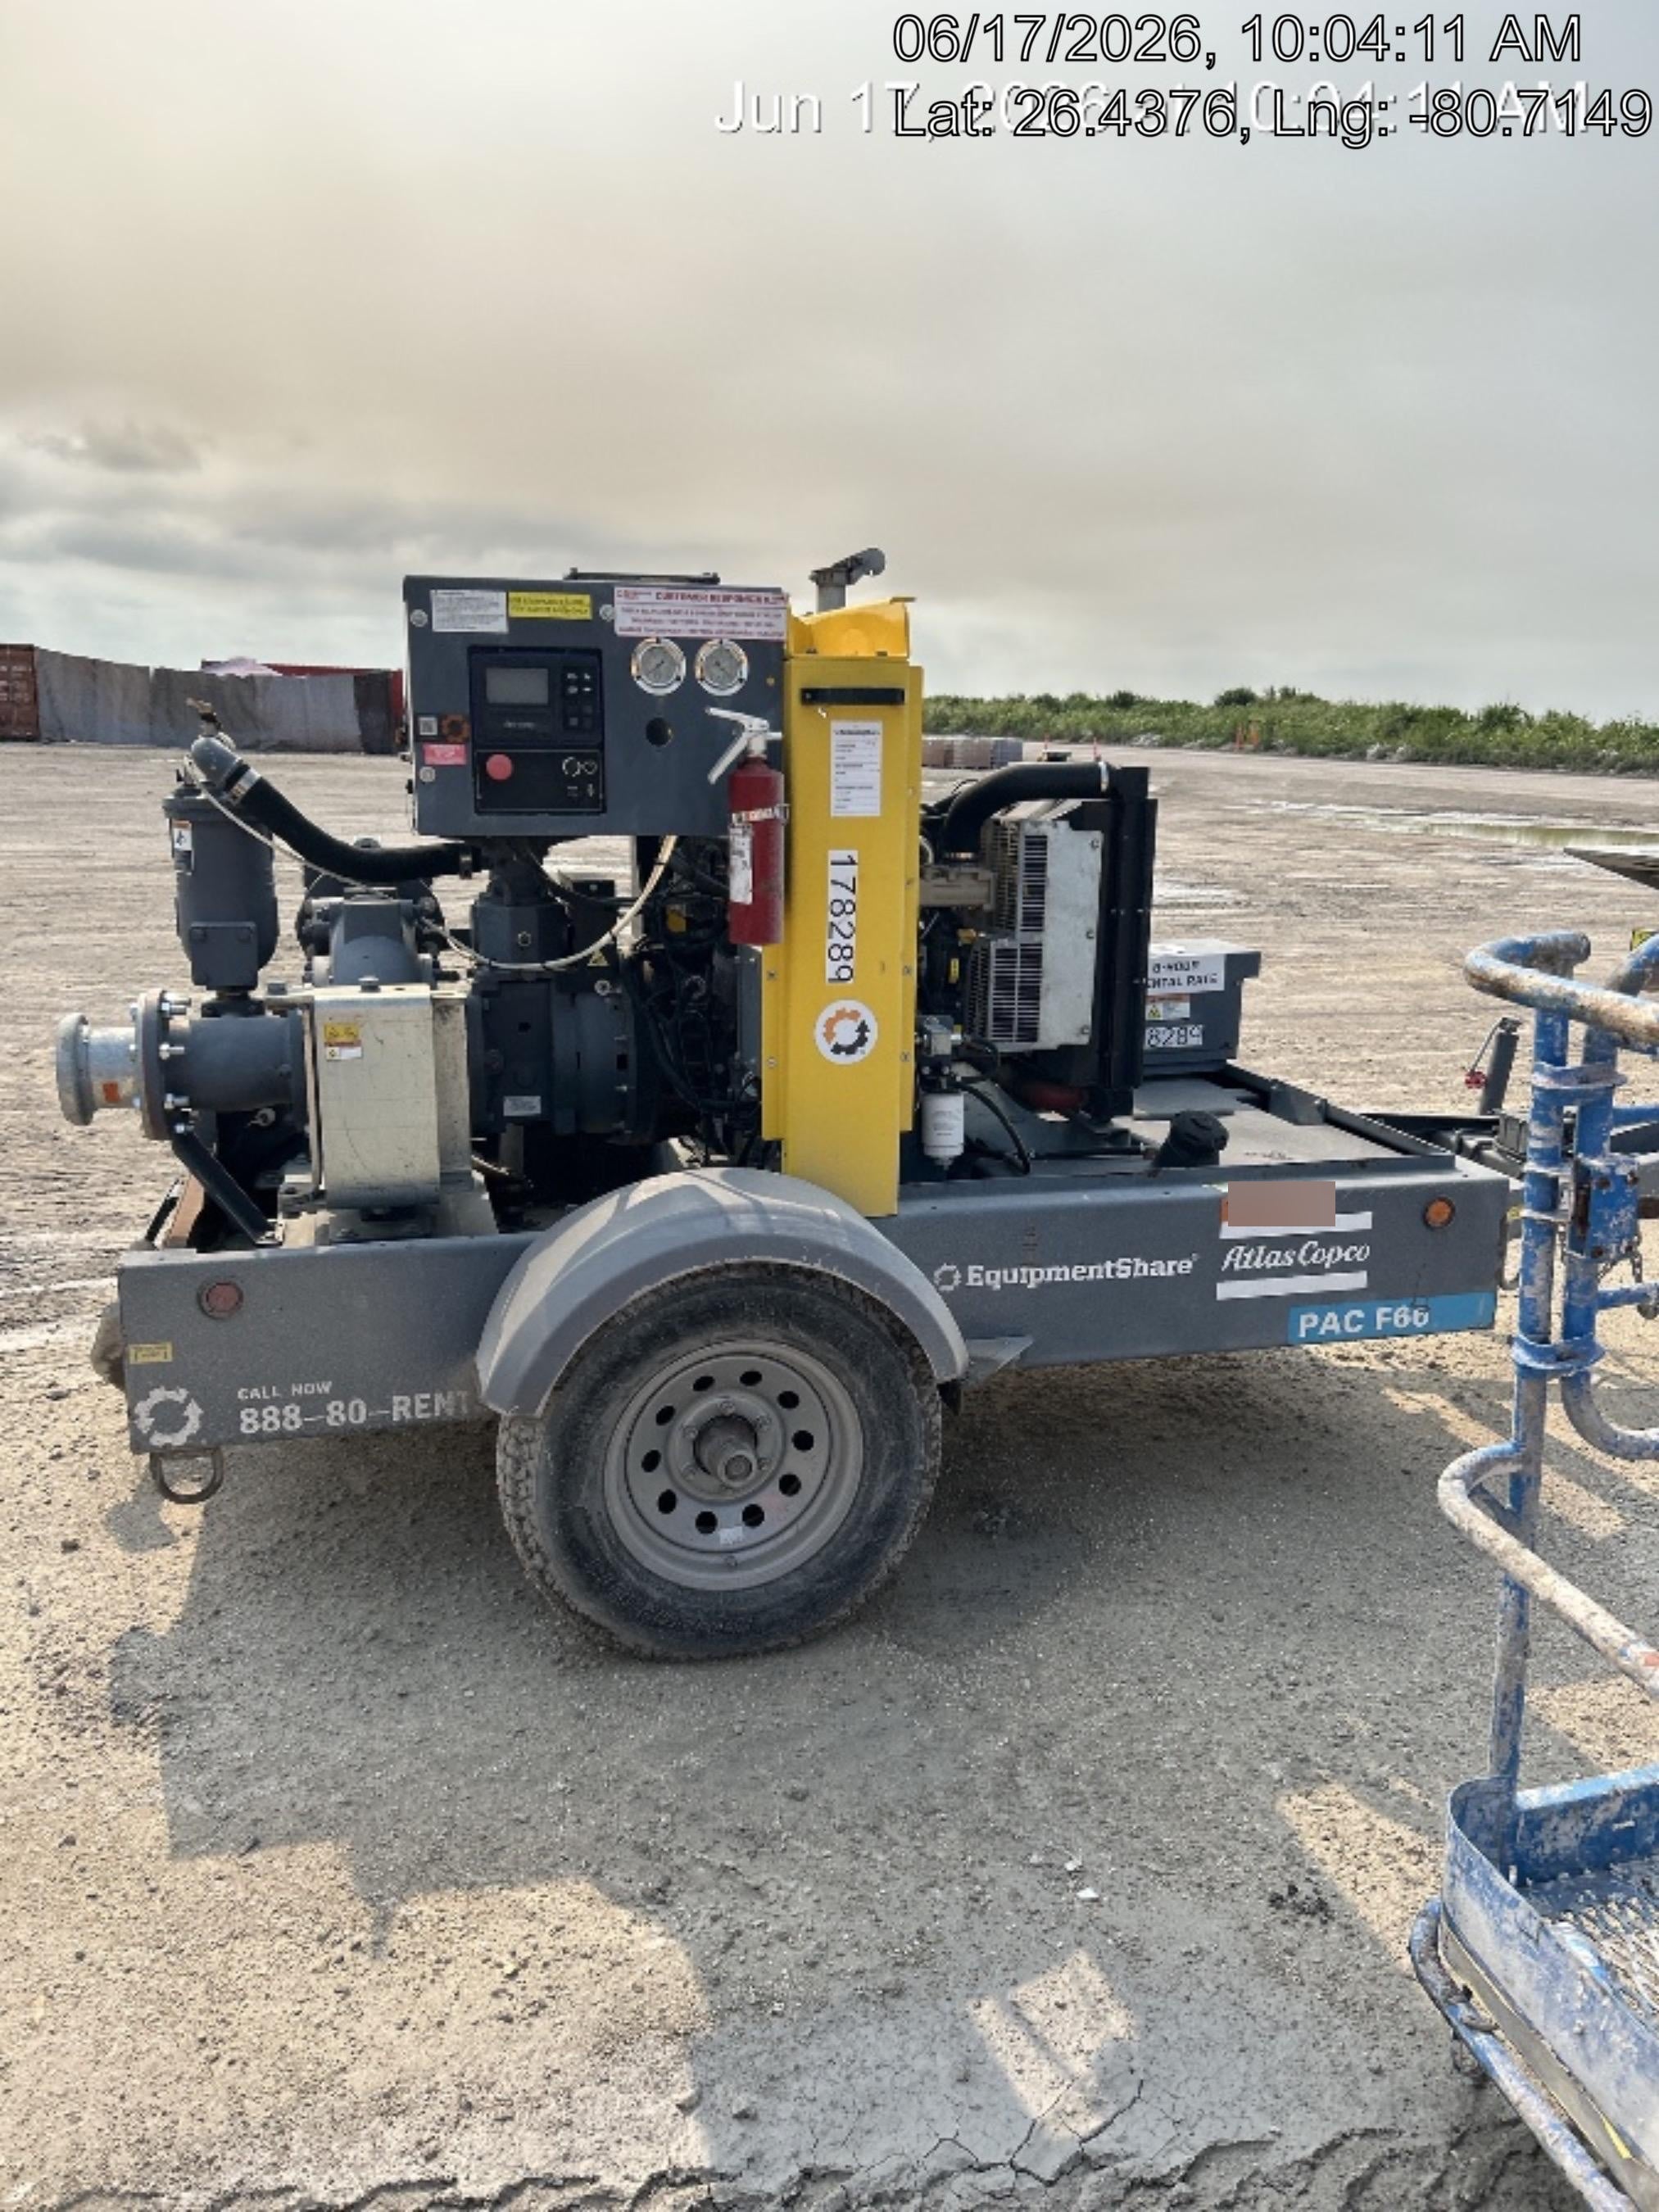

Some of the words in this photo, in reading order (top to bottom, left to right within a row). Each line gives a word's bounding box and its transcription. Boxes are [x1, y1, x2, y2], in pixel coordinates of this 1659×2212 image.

[828, 854, 859, 983] 178289
[1222, 1244, 1294, 1271] Atlas
[1298, 1240, 1371, 1269] Copco
[966, 1258, 1194, 1290] EquipmentShare
[1299, 1309, 1365, 1338] PAC
[238, 1386, 280, 1400] CALL
[292, 1381, 333, 1396] NOW
